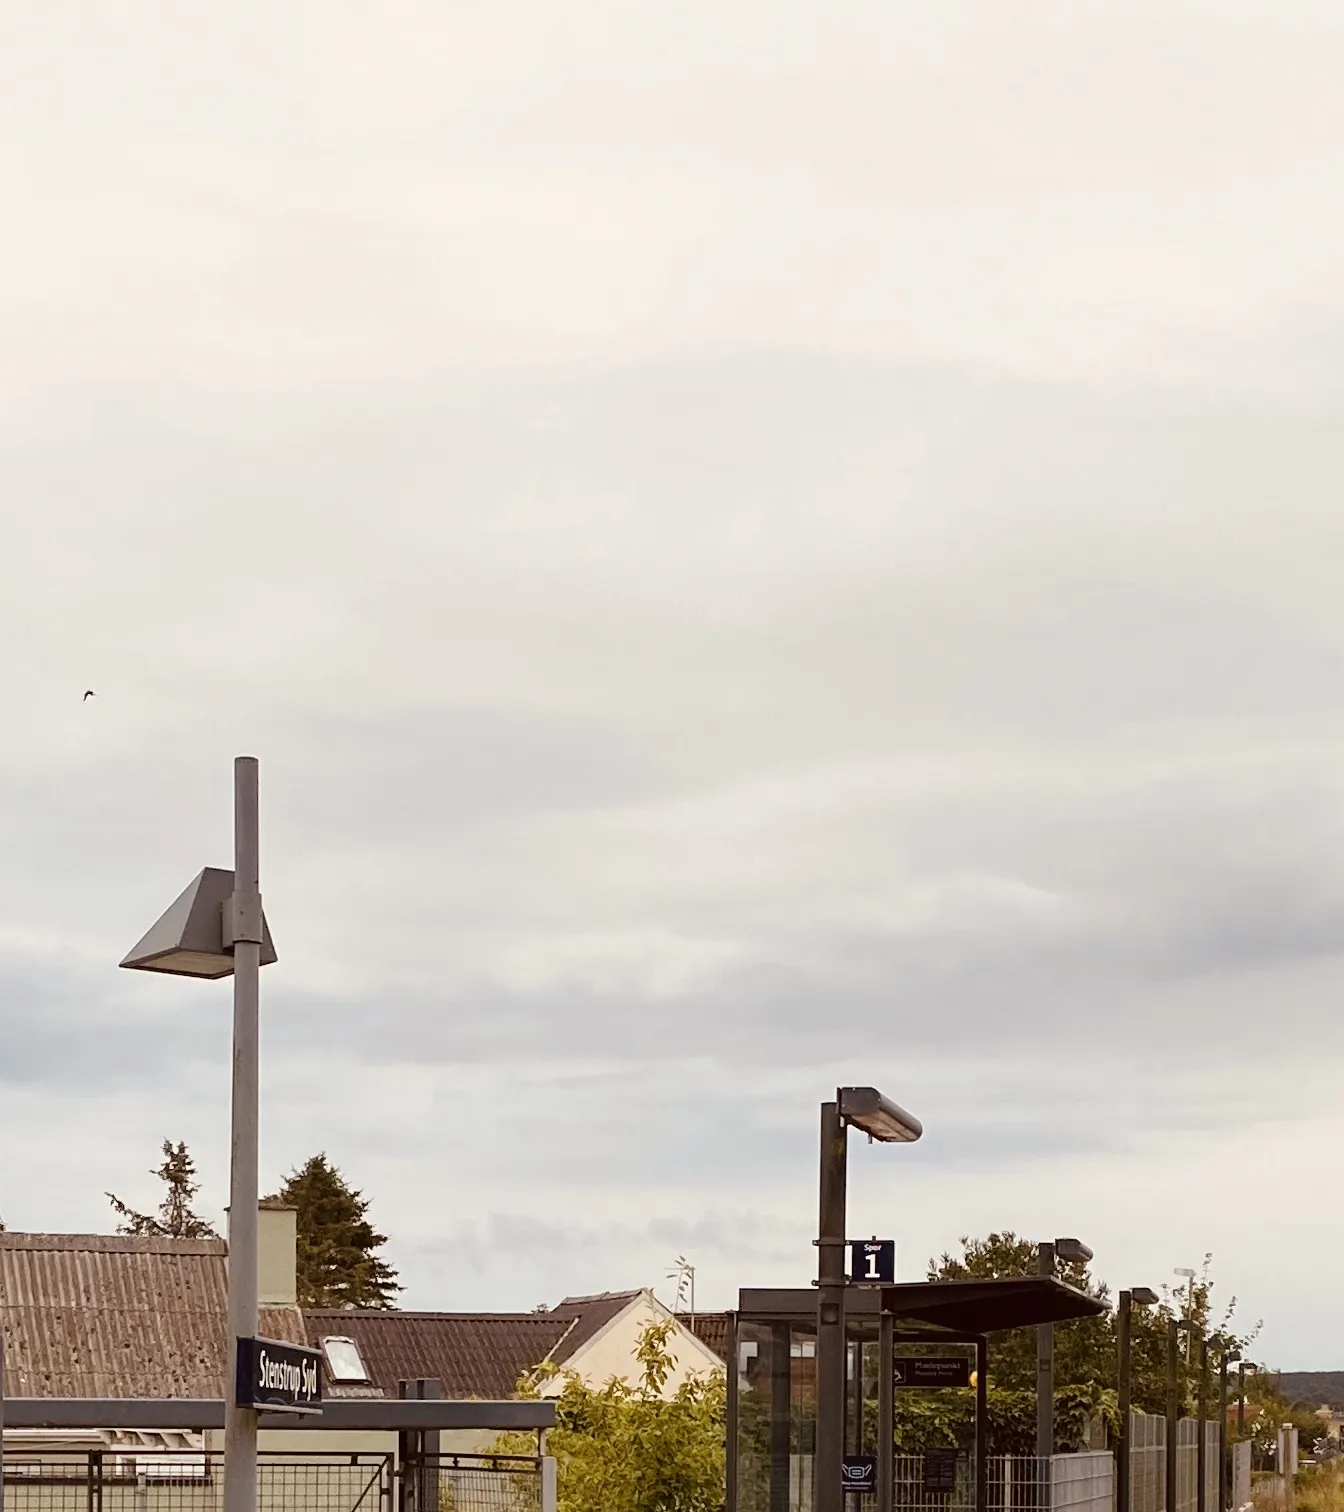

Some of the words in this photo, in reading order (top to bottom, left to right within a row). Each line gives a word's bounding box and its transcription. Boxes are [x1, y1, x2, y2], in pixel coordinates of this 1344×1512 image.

[865, 1253, 881, 1278] 1
[259, 1350, 301, 1401] Stenstrup
[301, 1358, 317, 1401] Syd
